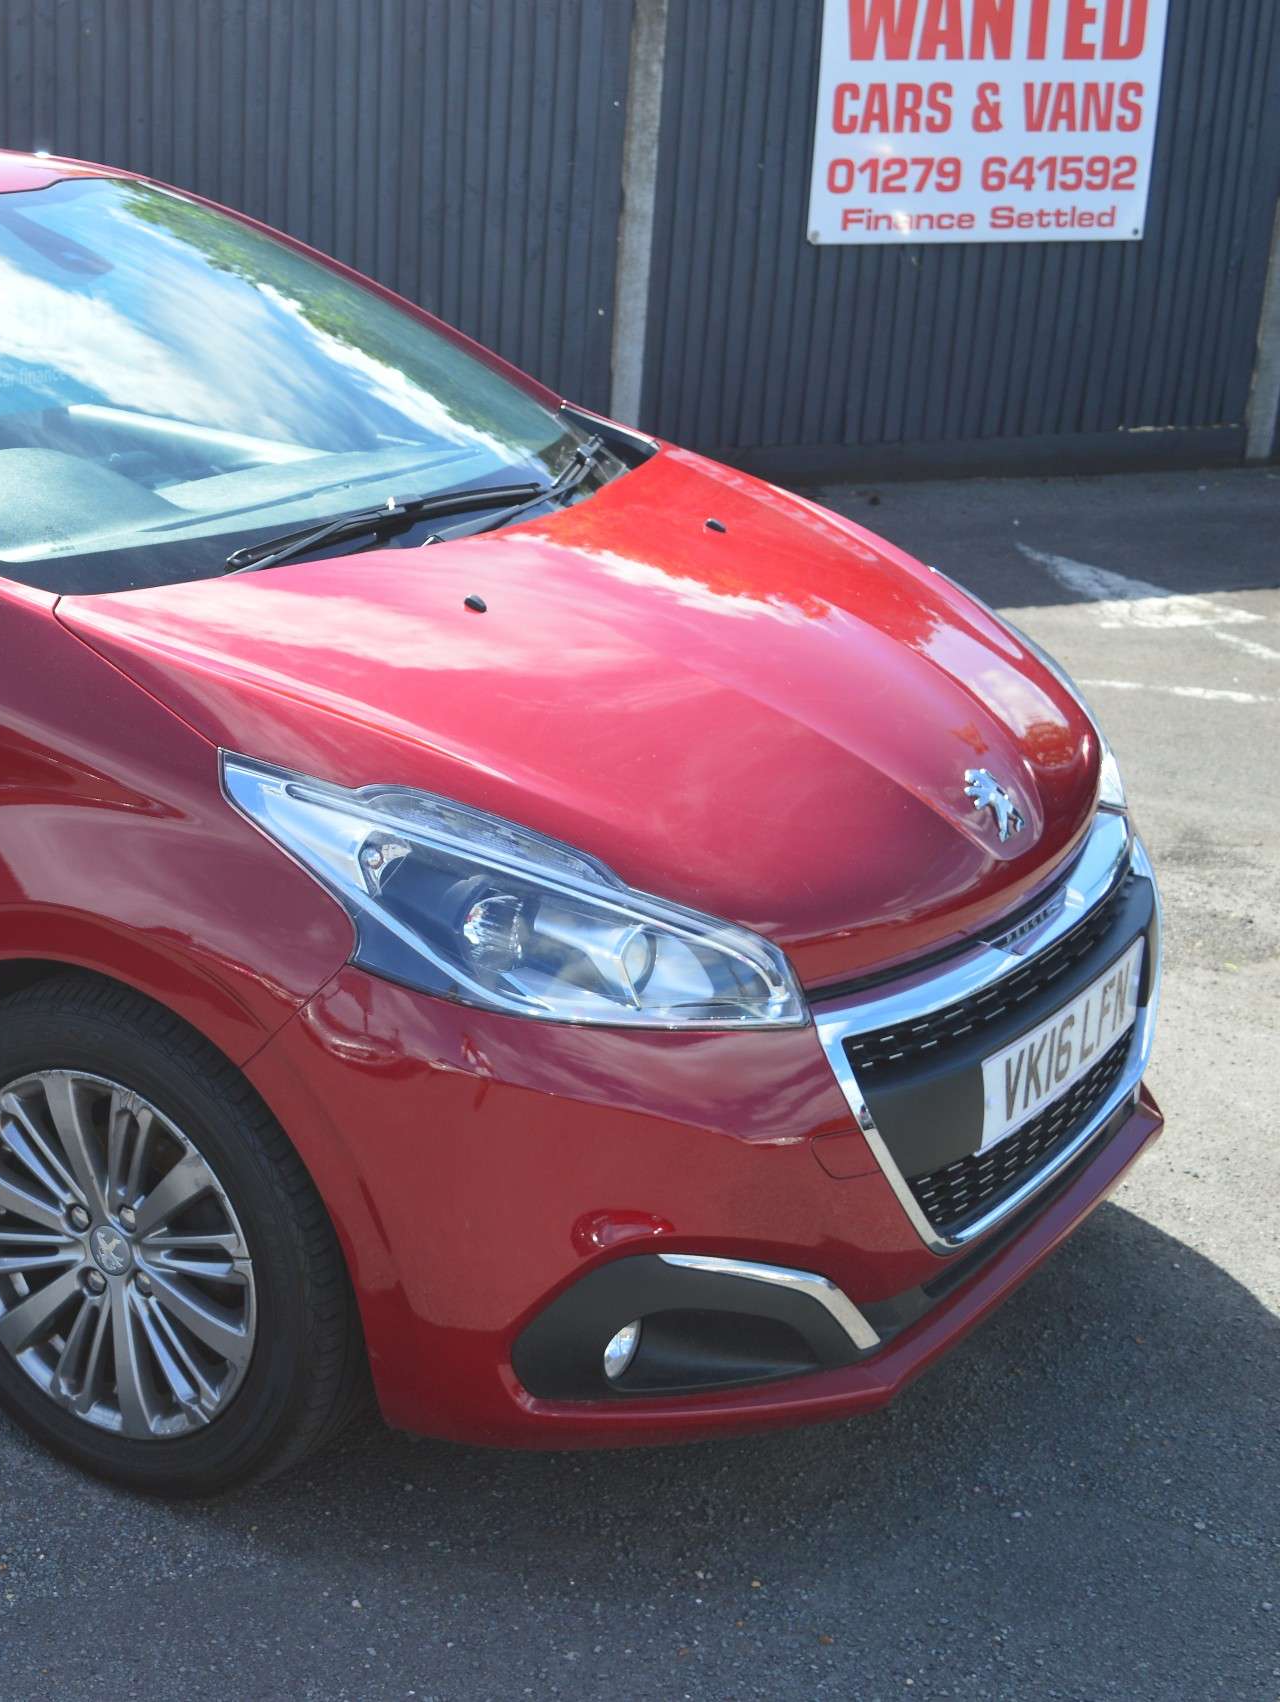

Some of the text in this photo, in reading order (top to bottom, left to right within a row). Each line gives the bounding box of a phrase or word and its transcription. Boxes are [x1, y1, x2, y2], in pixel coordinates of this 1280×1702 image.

[847, 0, 1148, 61] WANTED
[832, 81, 1144, 134] CARS & VANS
[826, 155, 1137, 194] 01279 641592
[841, 205, 1117, 231] Finance Settled
[1005, 961, 1131, 1122] VK16 LFN
